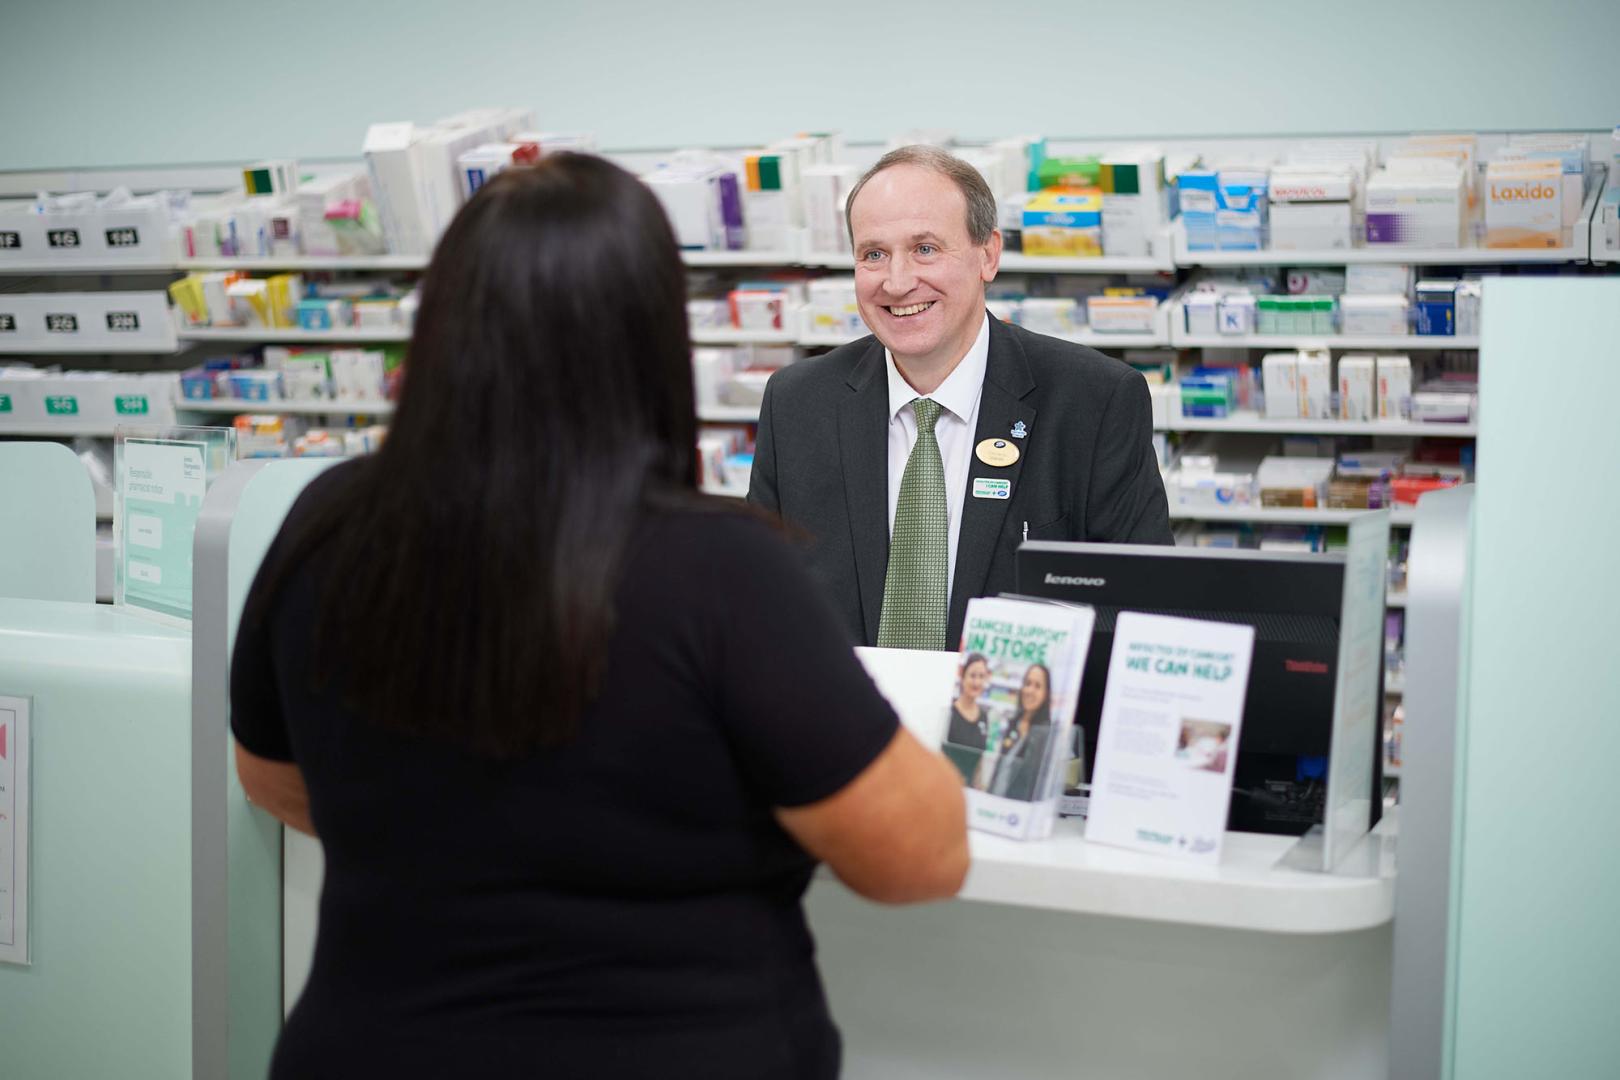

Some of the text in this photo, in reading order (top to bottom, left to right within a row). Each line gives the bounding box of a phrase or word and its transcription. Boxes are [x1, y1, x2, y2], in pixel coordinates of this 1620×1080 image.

[1490, 182, 1555, 202] Laxido
[52, 232, 75, 247] 1G
[1044, 572, 1106, 587] lenovo
[969, 617, 1069, 645] CANCER SUPPORT
[966, 633, 1048, 666] IN STORE
[1126, 655, 1233, 683] WE CAN HELP
